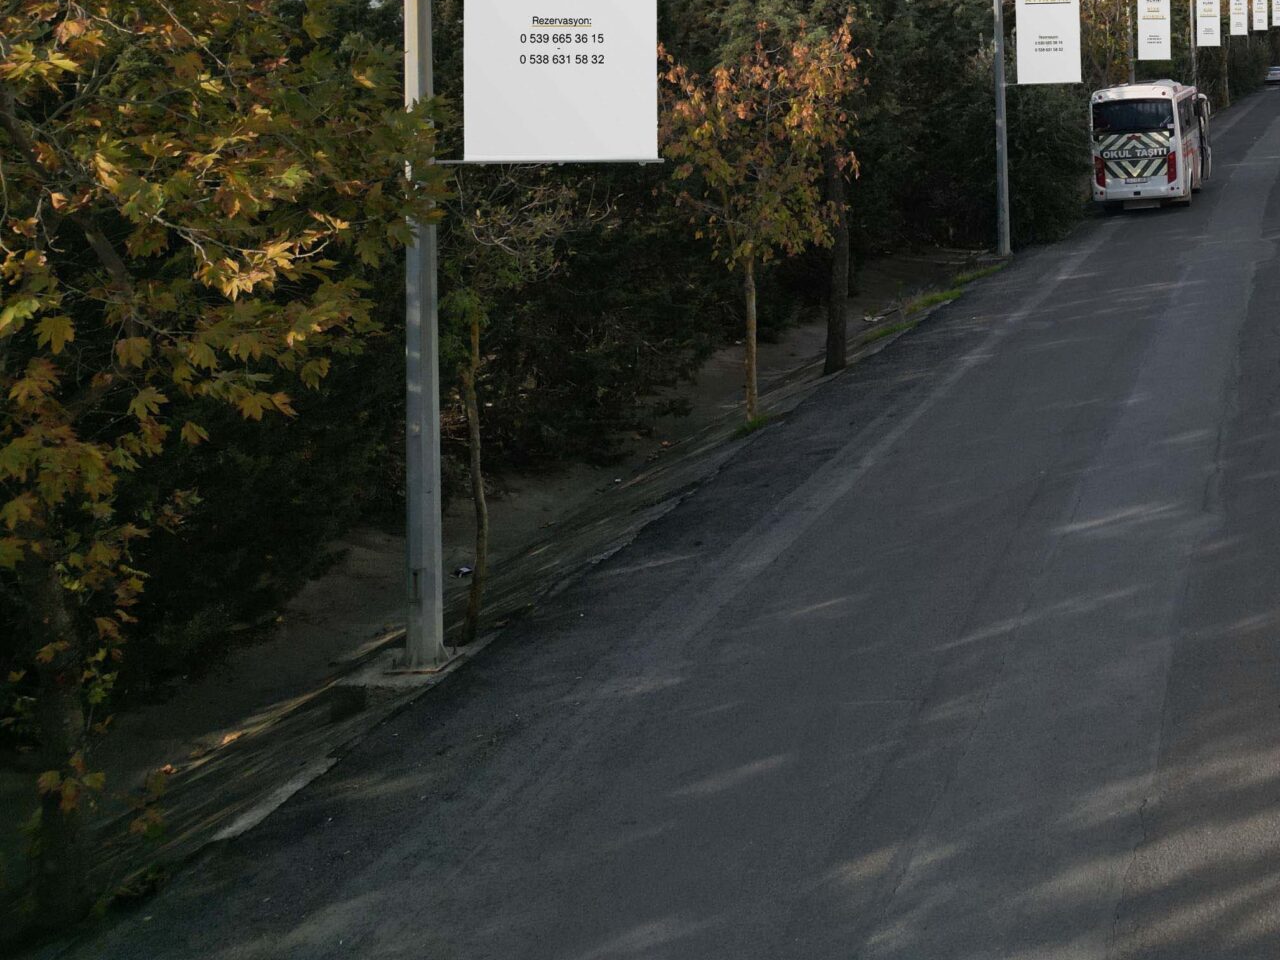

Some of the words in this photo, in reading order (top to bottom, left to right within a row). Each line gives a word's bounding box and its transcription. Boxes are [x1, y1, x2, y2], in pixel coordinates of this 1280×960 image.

[531, 16, 592, 27] Rezervasyon:
[520, 33, 527, 44] 0
[529, 33, 550, 44] 539
[552, 33, 572, 44] 665
[574, 33, 588, 44] 36
[591, 33, 604, 44] 15
[520, 54, 527, 65] 0
[529, 54, 550, 65] 538
[552, 54, 571, 65] 631
[574, 54, 588, 65] 58
[591, 54, 605, 65] 32
[1103, 150, 1132, 159] OKUL
[1135, 147, 1168, 158] TAŞITI
